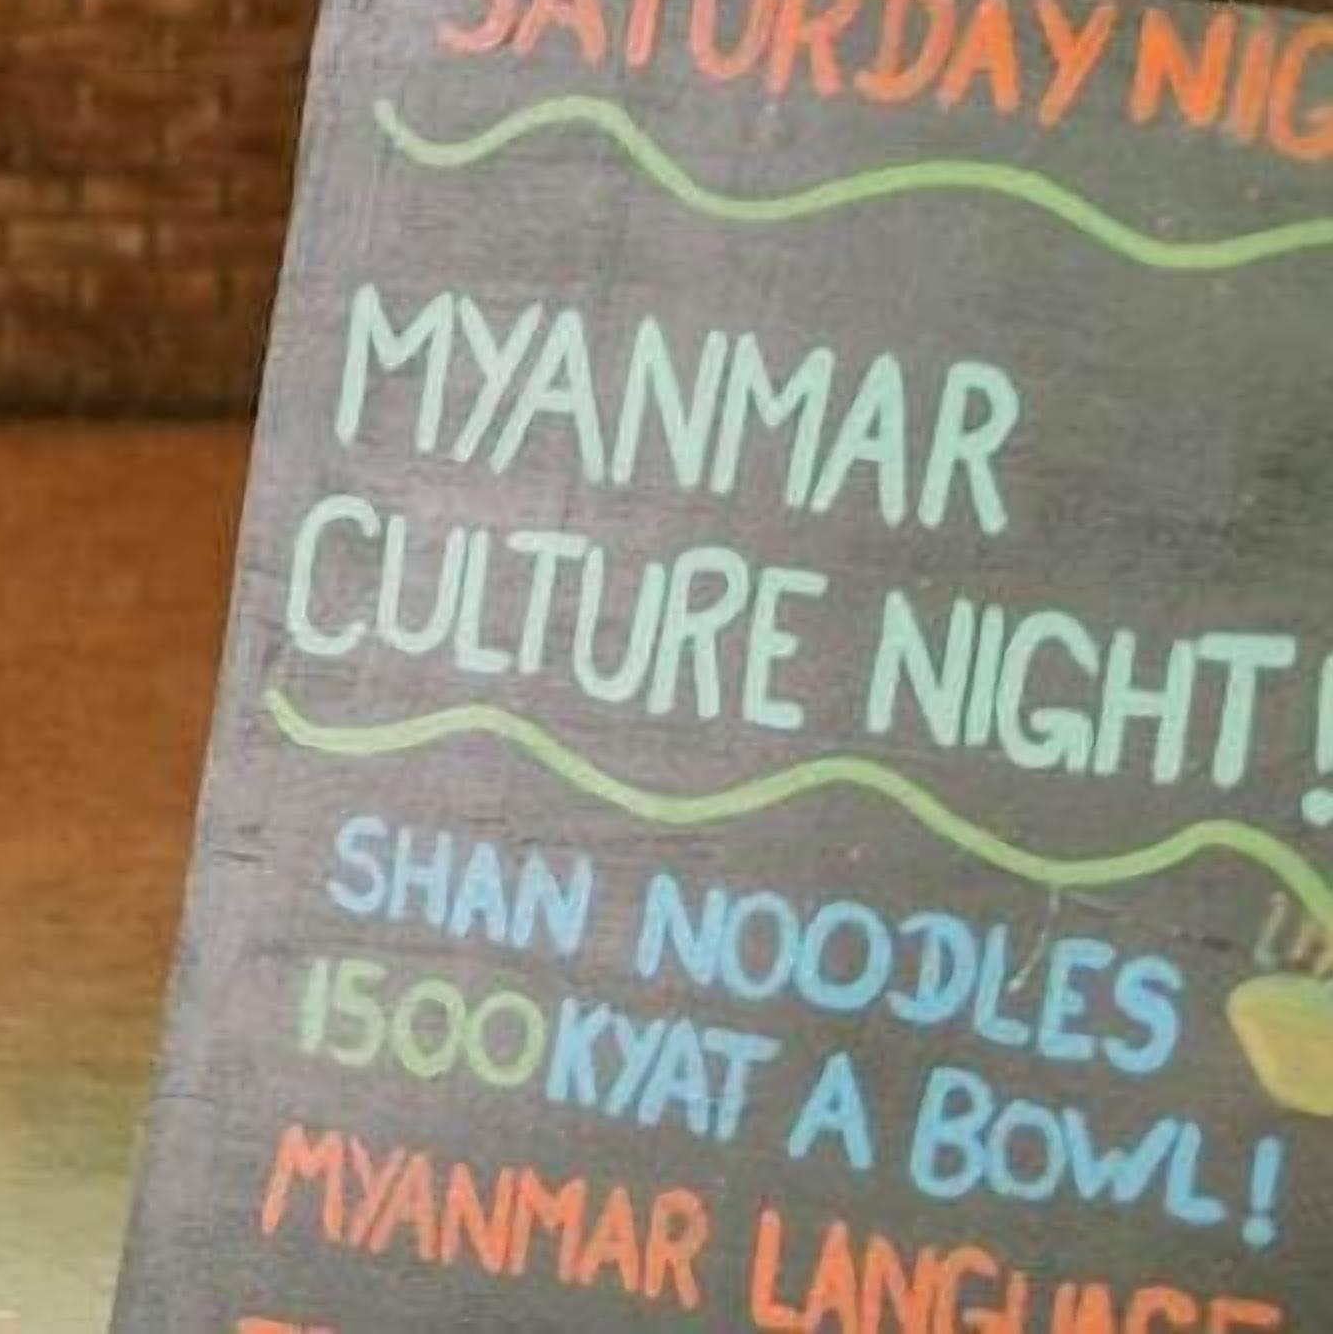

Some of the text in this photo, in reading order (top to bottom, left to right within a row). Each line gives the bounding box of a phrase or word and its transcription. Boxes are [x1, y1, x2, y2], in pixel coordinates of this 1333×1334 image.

[1128, 0, 1333, 161] NIG
[336, 283, 1021, 537] MYANMAR
[285, 494, 1333, 828] CULTURE NIGHT!
[324, 814, 1184, 1074] SHAN NOODLES
[789, 1050, 873, 1169] A
[259, 1122, 1281, 1334] MYANMAR LANGU
